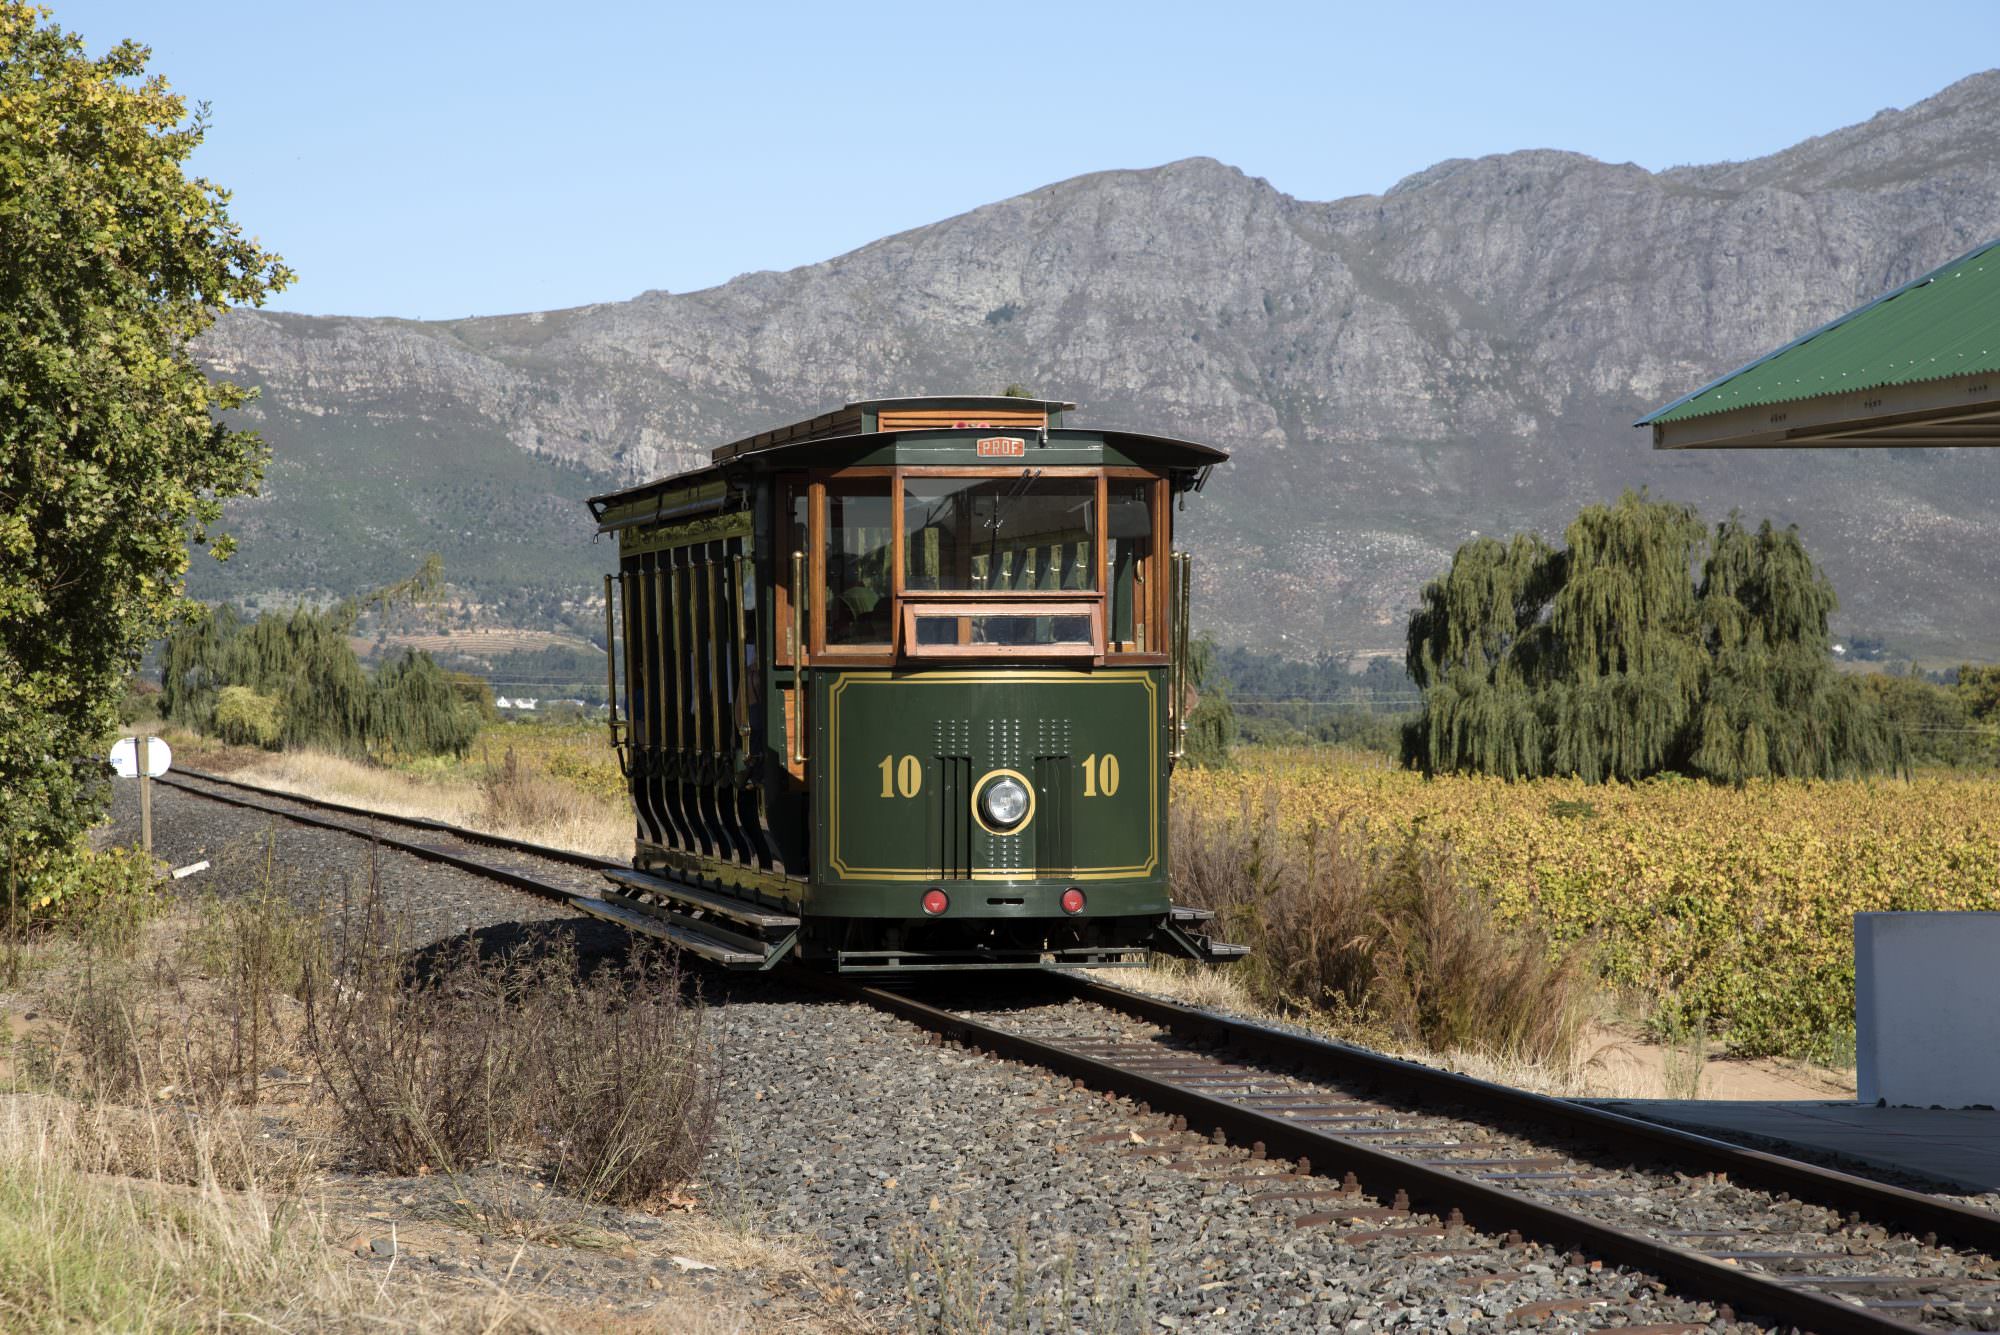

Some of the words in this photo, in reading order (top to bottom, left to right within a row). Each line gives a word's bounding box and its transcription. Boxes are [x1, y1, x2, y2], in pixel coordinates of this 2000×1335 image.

[983, 440, 1019, 455] PROF
[878, 755, 922, 798] 10
[1082, 753, 1120, 797] 10
